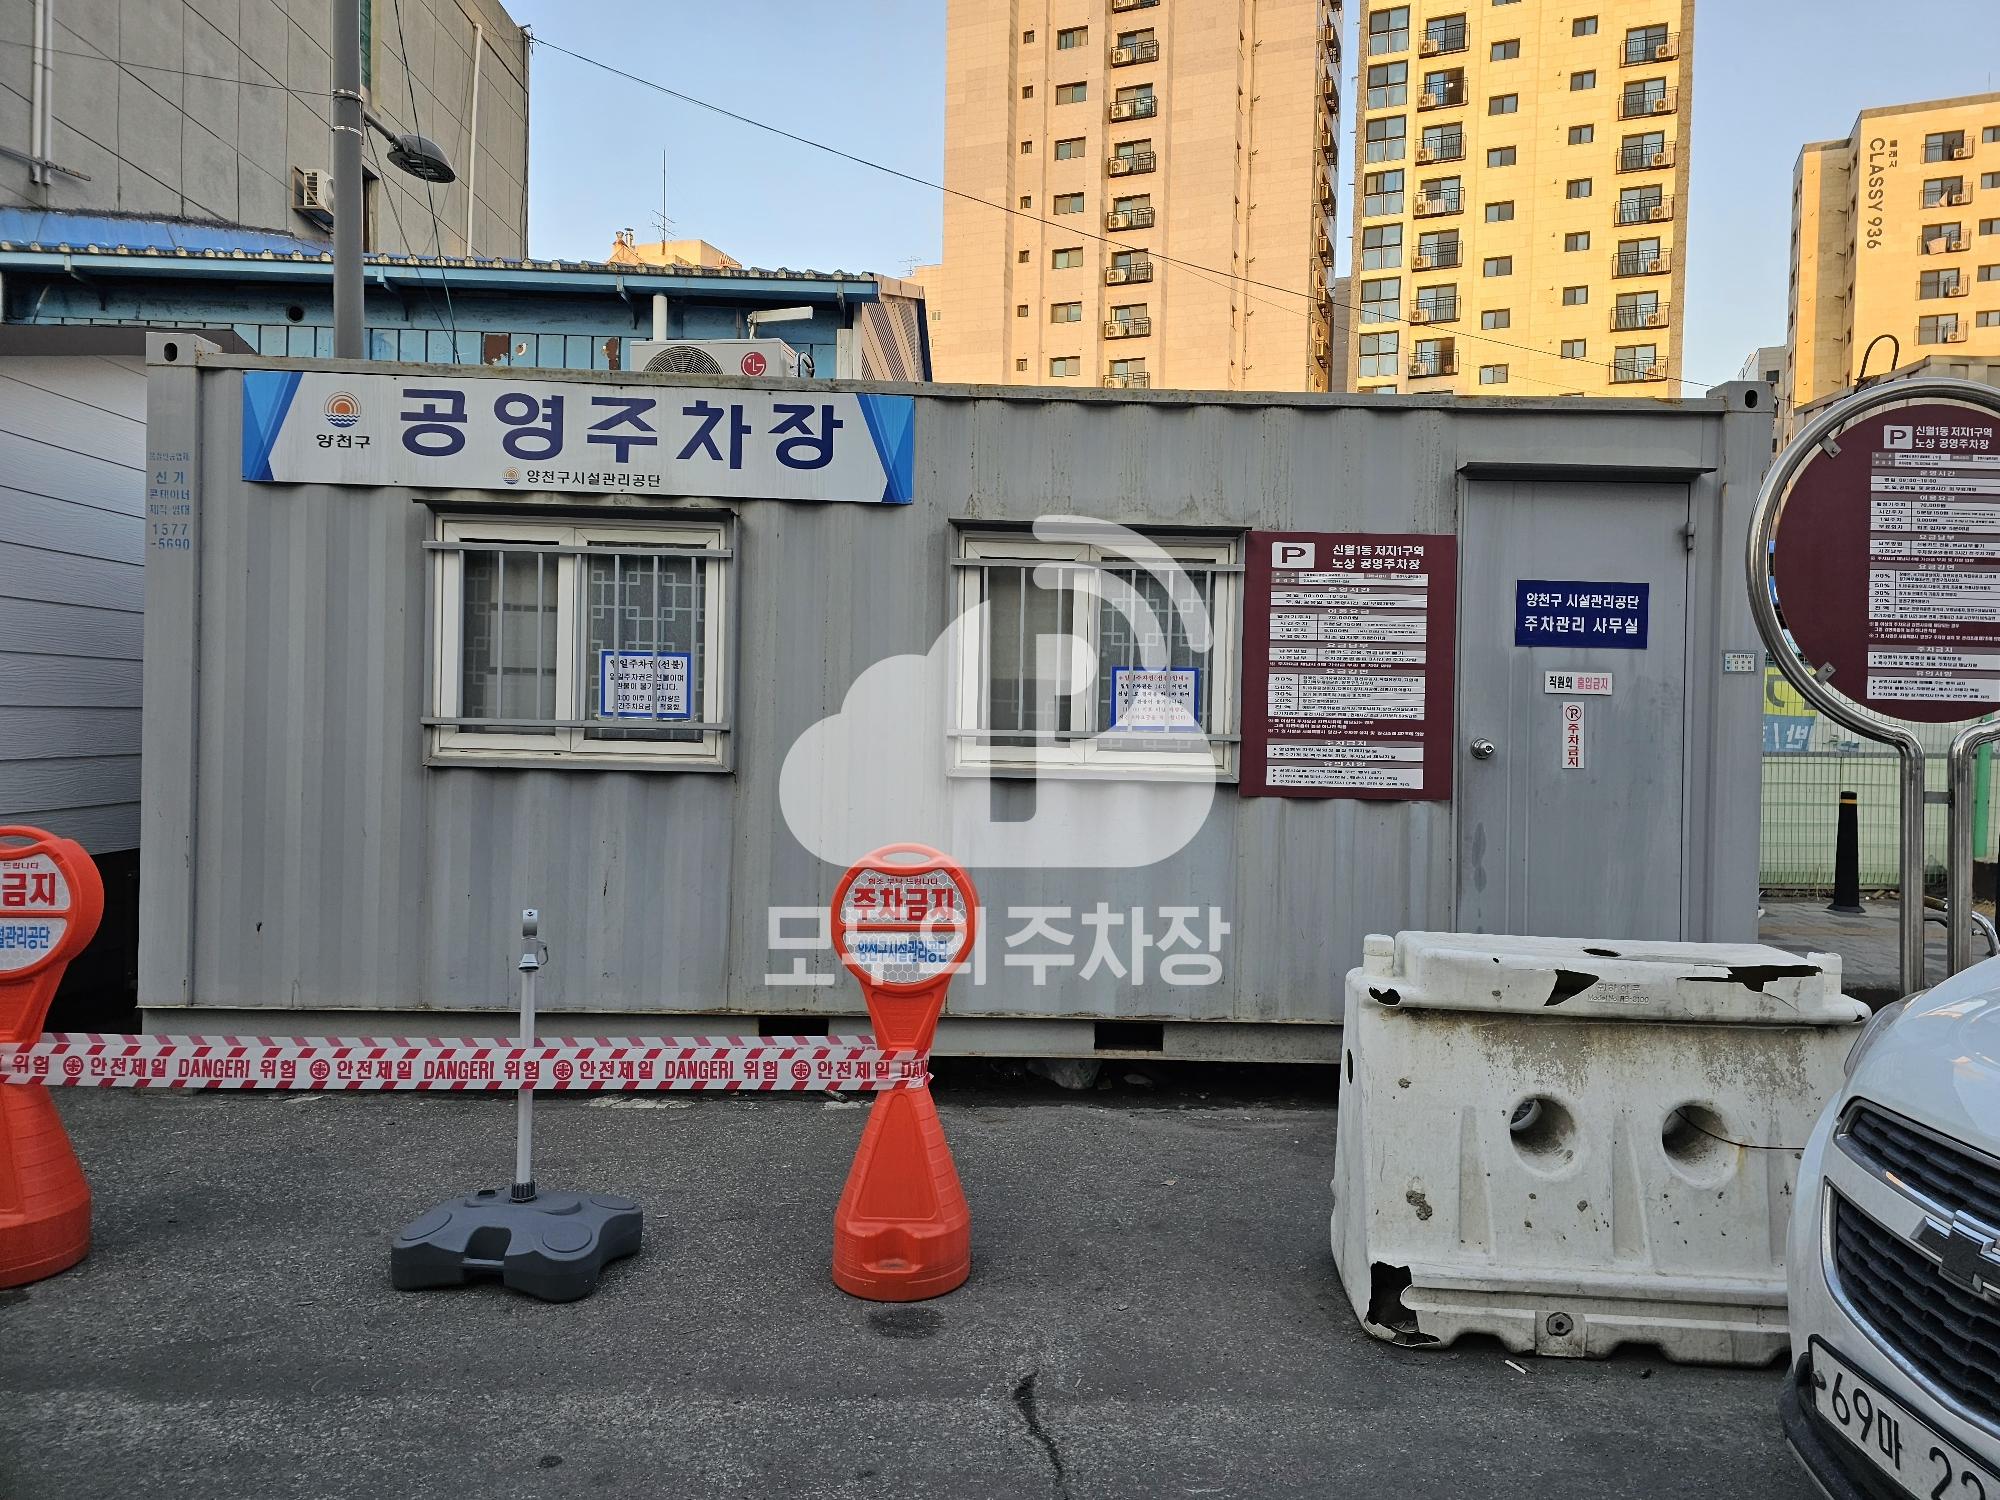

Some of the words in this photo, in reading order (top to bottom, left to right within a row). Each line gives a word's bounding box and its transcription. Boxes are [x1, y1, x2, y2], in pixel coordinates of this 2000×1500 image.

[1868, 138, 1885, 211] CLASSY
[1867, 217, 1882, 249] 936
[400, 388, 843, 470] 공영주차장
[1915, 426, 1948, 437] 신월1동
[1951, 427, 1993, 438] 저지1구역
[316, 432, 371, 450] 양천구
[1915, 439, 1935, 449] 노상
[1939, 440, 1989, 450] 공영주차장
[526, 468, 661, 489] 양천구시설관리공단
[153, 523, 188, 536] 1577
[1332, 544, 1372, 557] 신월1동
[1375, 545, 1425, 557] 저지1구역
[1332, 558, 1356, 569] 노상
[1360, 559, 1421, 570] 공영주차장
[1526, 593, 1562, 607] 양천구
[1566, 594, 1639, 609] 시설관리공단
[1524, 616, 1585, 633] 주차관리
[1593, 617, 1638, 634] 사무실
[1549, 675, 1573, 689] 직원외
[1577, 677, 1608, 690] 출입금지
[1567, 724, 1580, 768] 주차금지
[2, 873, 56, 906] 금지
[854, 888, 953, 920] 주차금지
[12, 1055, 49, 1075] 위험
[90, 1056, 167, 1078] 안전제일
[259, 1059, 296, 1079] 위험
[336, 1060, 412, 1080] 안전제일
[503, 1060, 540, 1080] 위험
[579, 1060, 653, 1080] 안전제일
[743, 1061, 778, 1080] 위험
[818, 1061, 890, 1080] 안전제일
[1832, 1372, 1903, 1471] 69마
